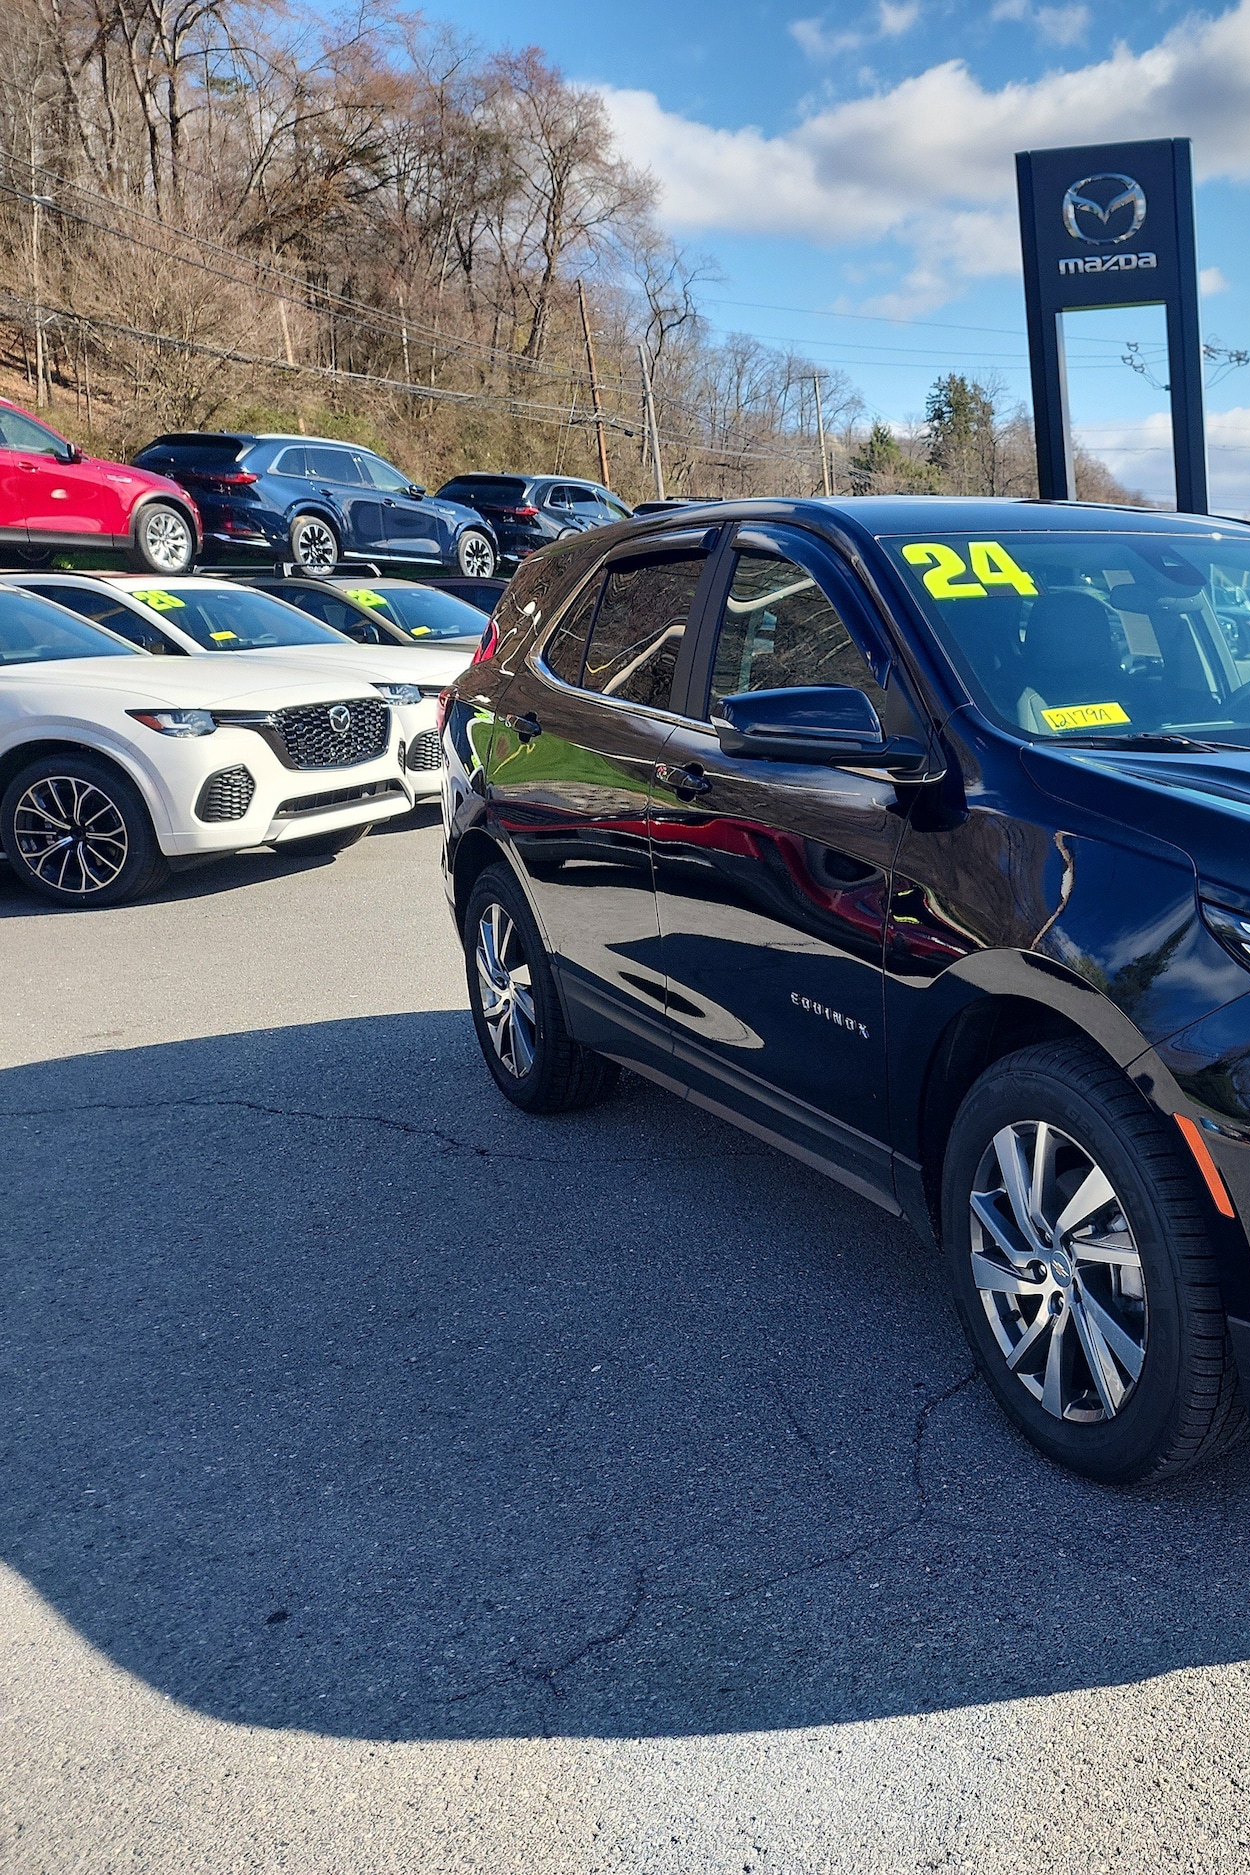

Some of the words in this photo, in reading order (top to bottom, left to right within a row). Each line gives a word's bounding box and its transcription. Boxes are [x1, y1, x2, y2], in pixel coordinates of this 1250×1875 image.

[1059, 252, 1157, 274] mazda
[901, 541, 1039, 599] 24
[132, 590, 186, 611] 26
[791, 992, 870, 1039] EQUINOX
